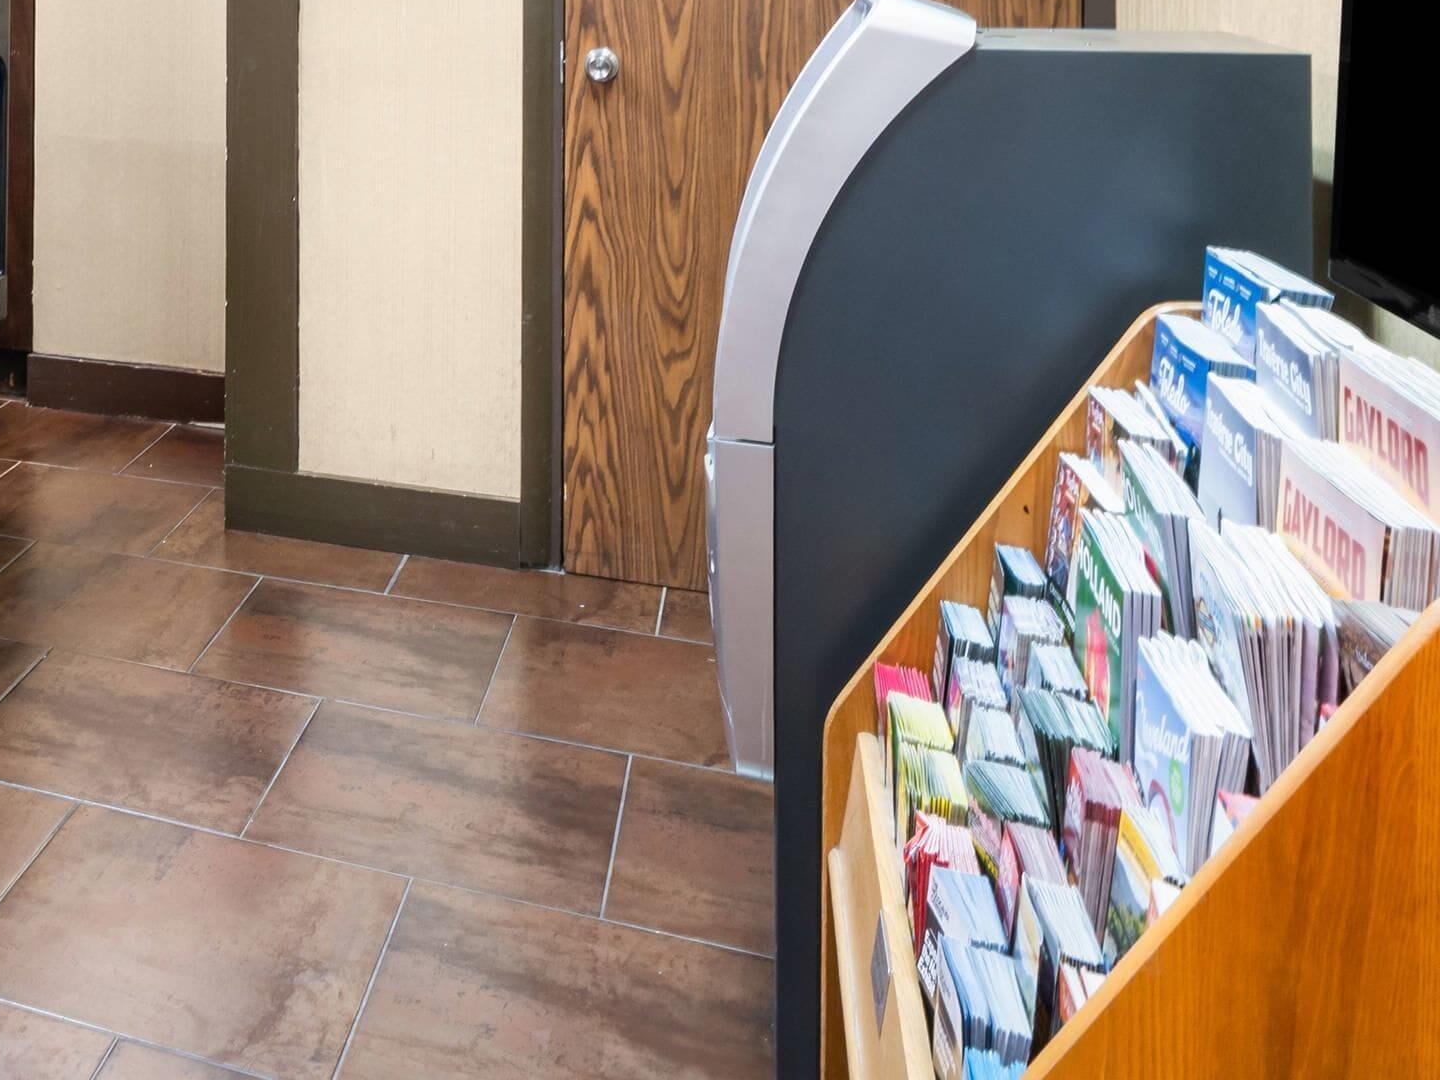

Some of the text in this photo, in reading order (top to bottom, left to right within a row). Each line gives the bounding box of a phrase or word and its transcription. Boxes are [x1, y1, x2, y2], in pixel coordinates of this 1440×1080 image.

[1290, 361, 1313, 416] City
[1234, 432, 1253, 488] City
[1344, 385, 1430, 508] GAYLORD
[1078, 537, 1121, 639] HOLLAND
[1282, 476, 1367, 601] GAYLORD
